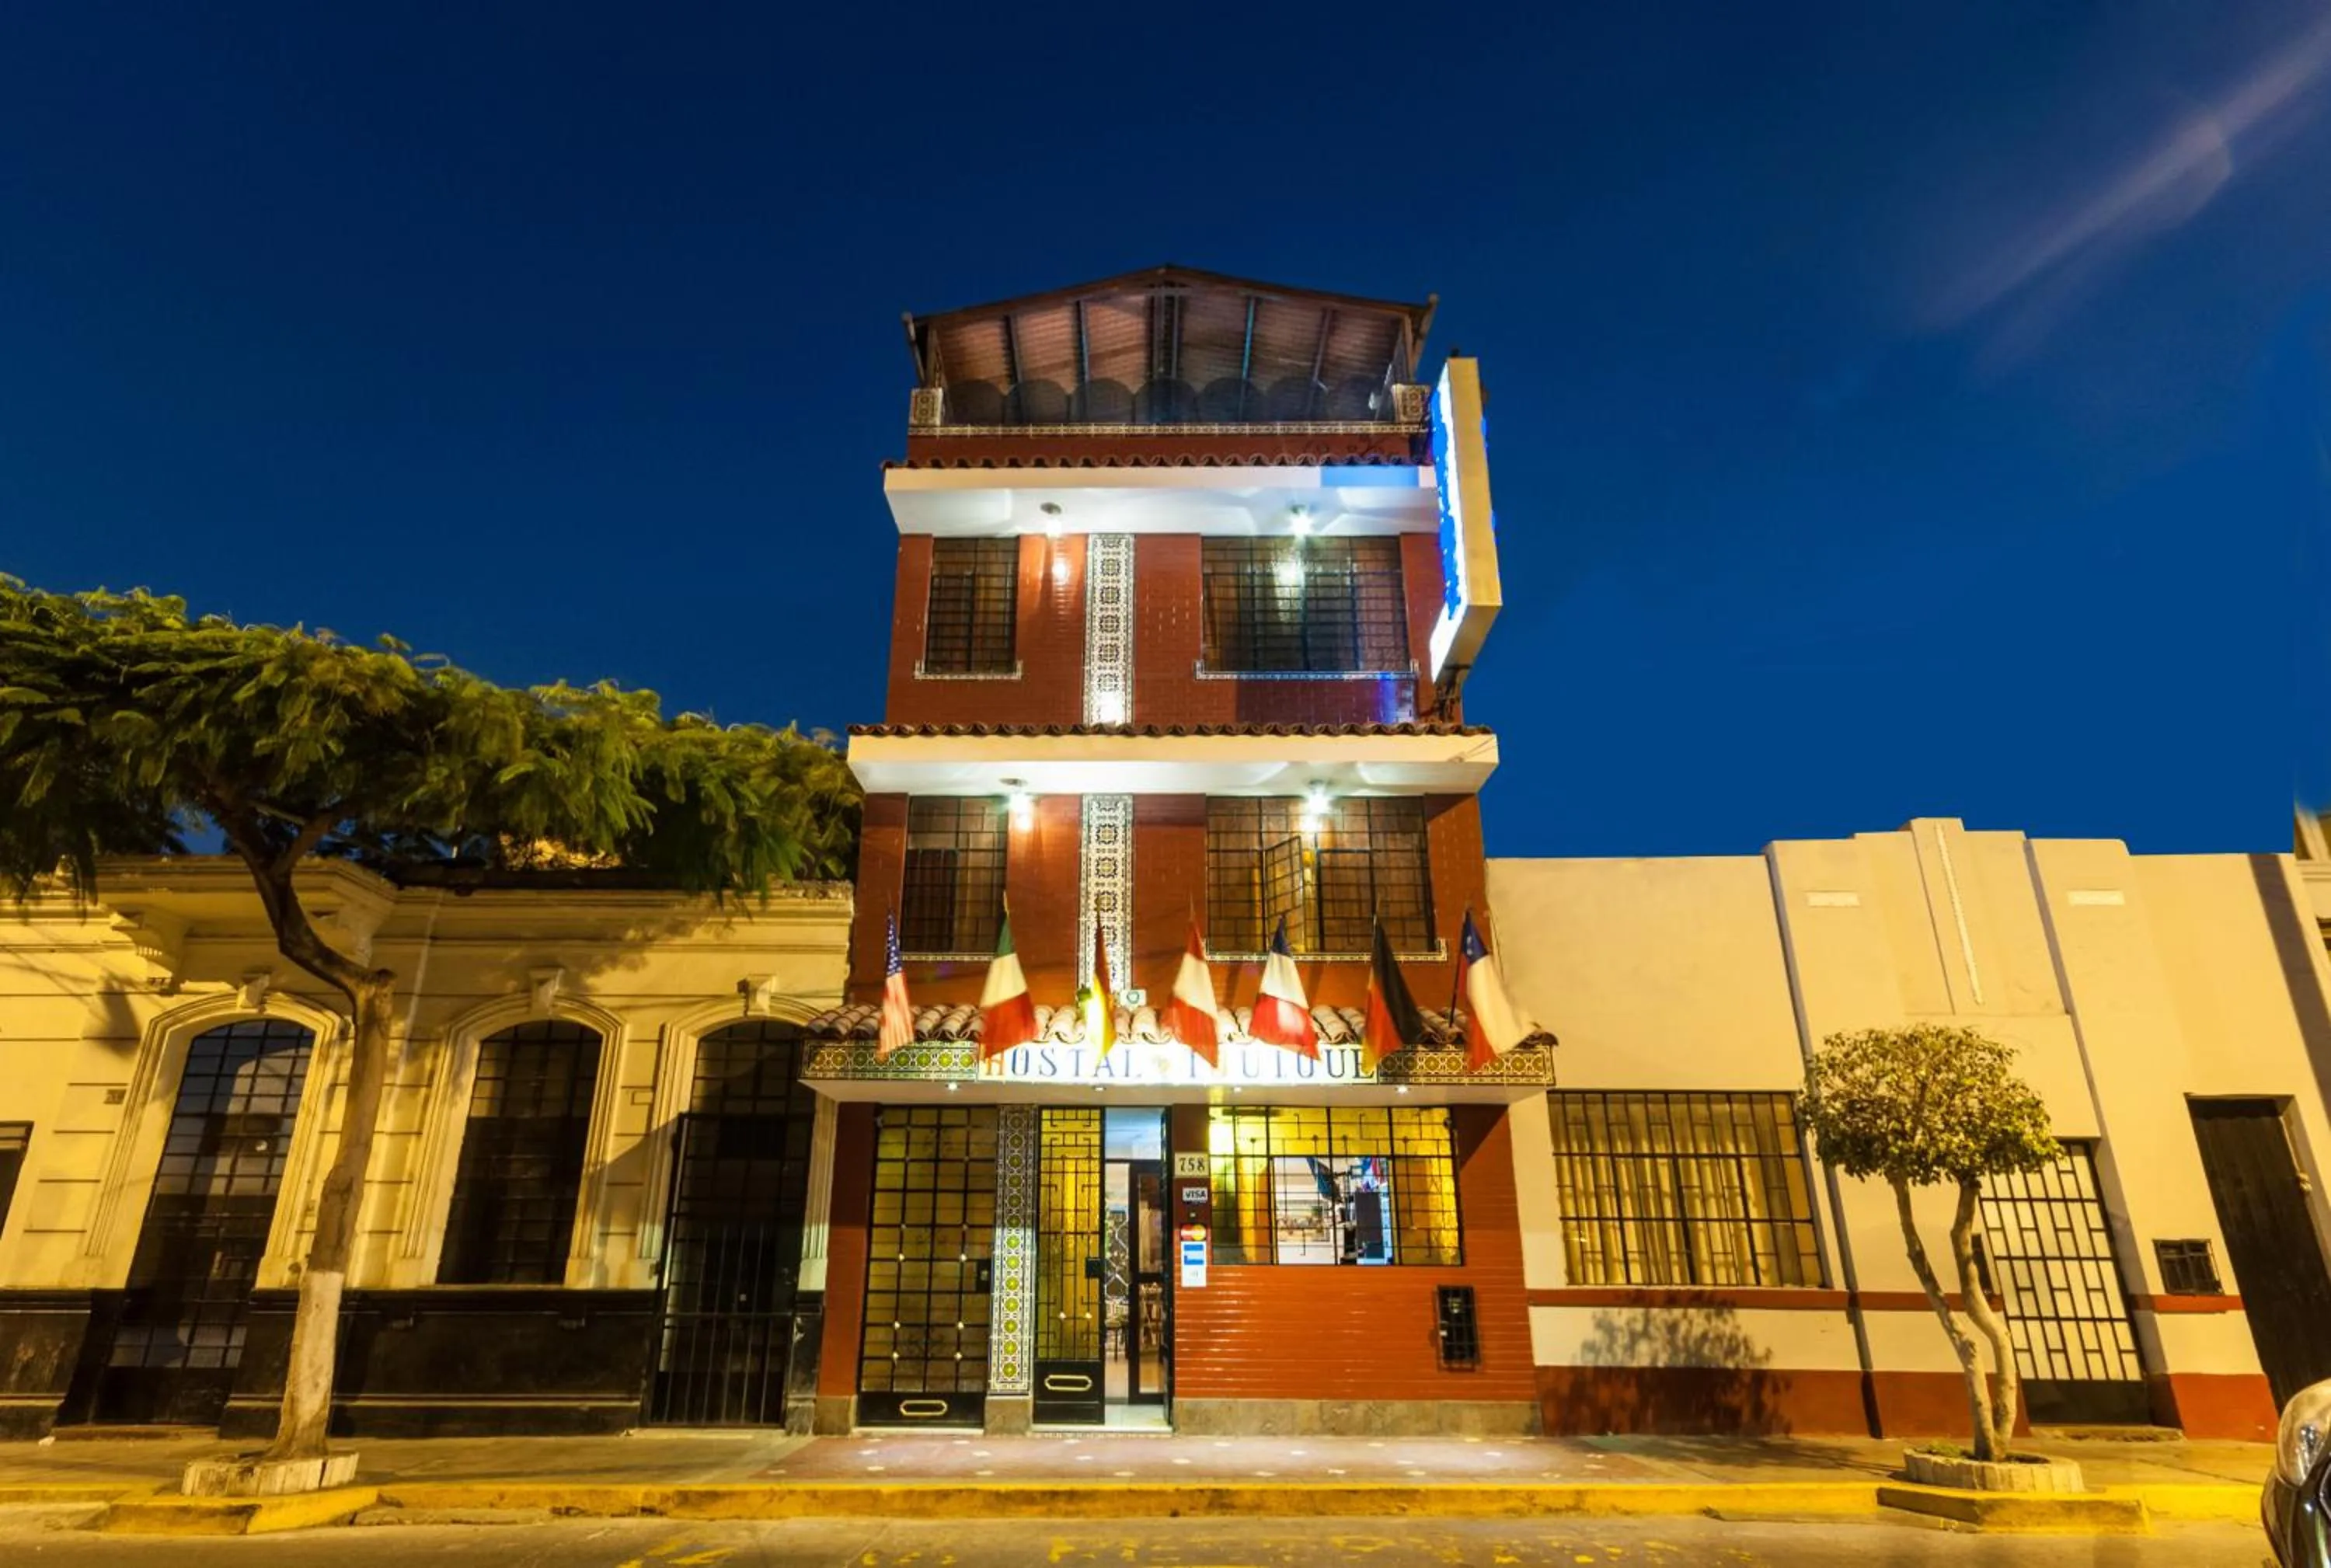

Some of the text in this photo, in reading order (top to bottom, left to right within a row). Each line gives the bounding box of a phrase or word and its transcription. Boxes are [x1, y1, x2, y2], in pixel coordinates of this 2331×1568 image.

[984, 1047, 1375, 1078] HOSTAL IUIUE
[1179, 1157, 1205, 1172] 758
[1185, 1190, 1207, 1199] VISA
